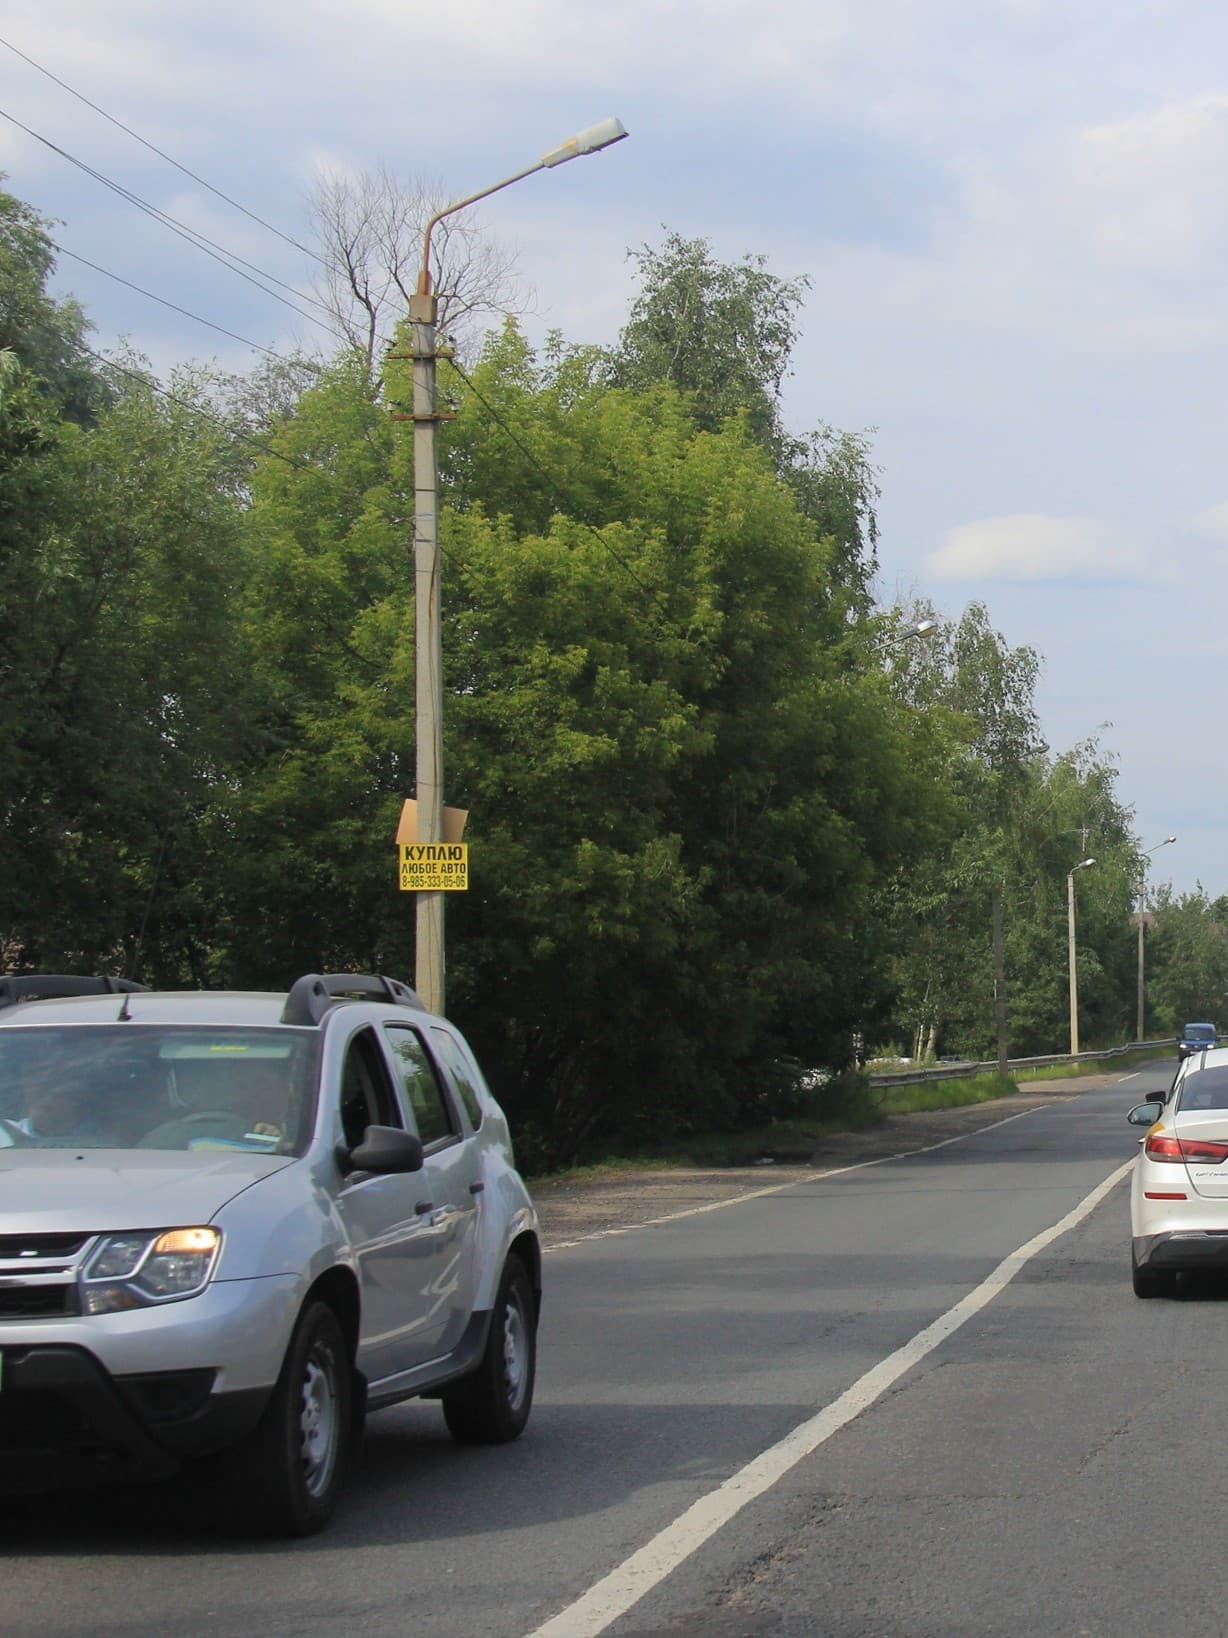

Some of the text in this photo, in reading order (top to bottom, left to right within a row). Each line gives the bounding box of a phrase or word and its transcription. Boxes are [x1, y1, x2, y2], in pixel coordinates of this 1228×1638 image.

[405, 846, 463, 861] КУПЛЮ
[401, 863, 466, 874] ЛЮБОЕ АВТО
